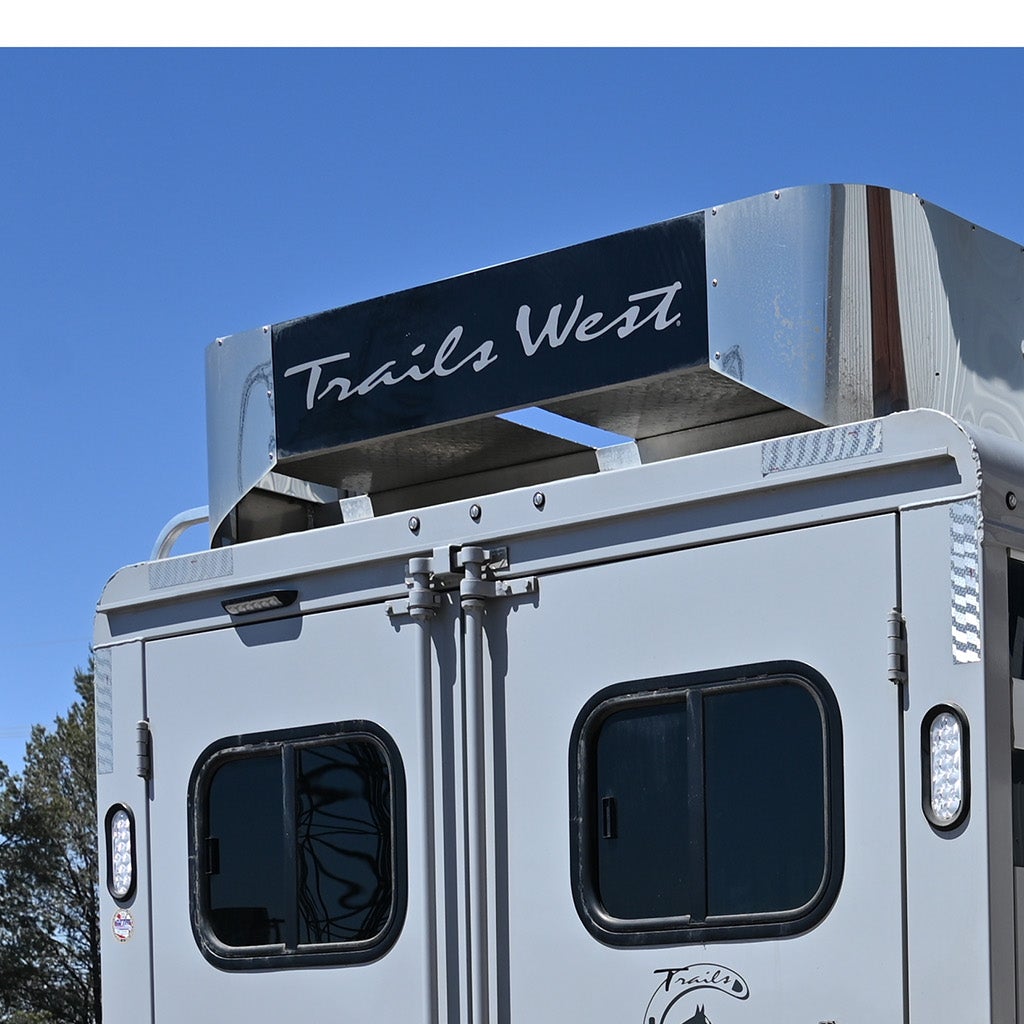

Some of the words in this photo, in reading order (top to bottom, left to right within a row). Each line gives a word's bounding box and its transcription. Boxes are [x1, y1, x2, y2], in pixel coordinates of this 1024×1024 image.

[284, 325, 498, 410] Trails
[515, 281, 682, 358] West
[654, 967, 731, 991] Trails
